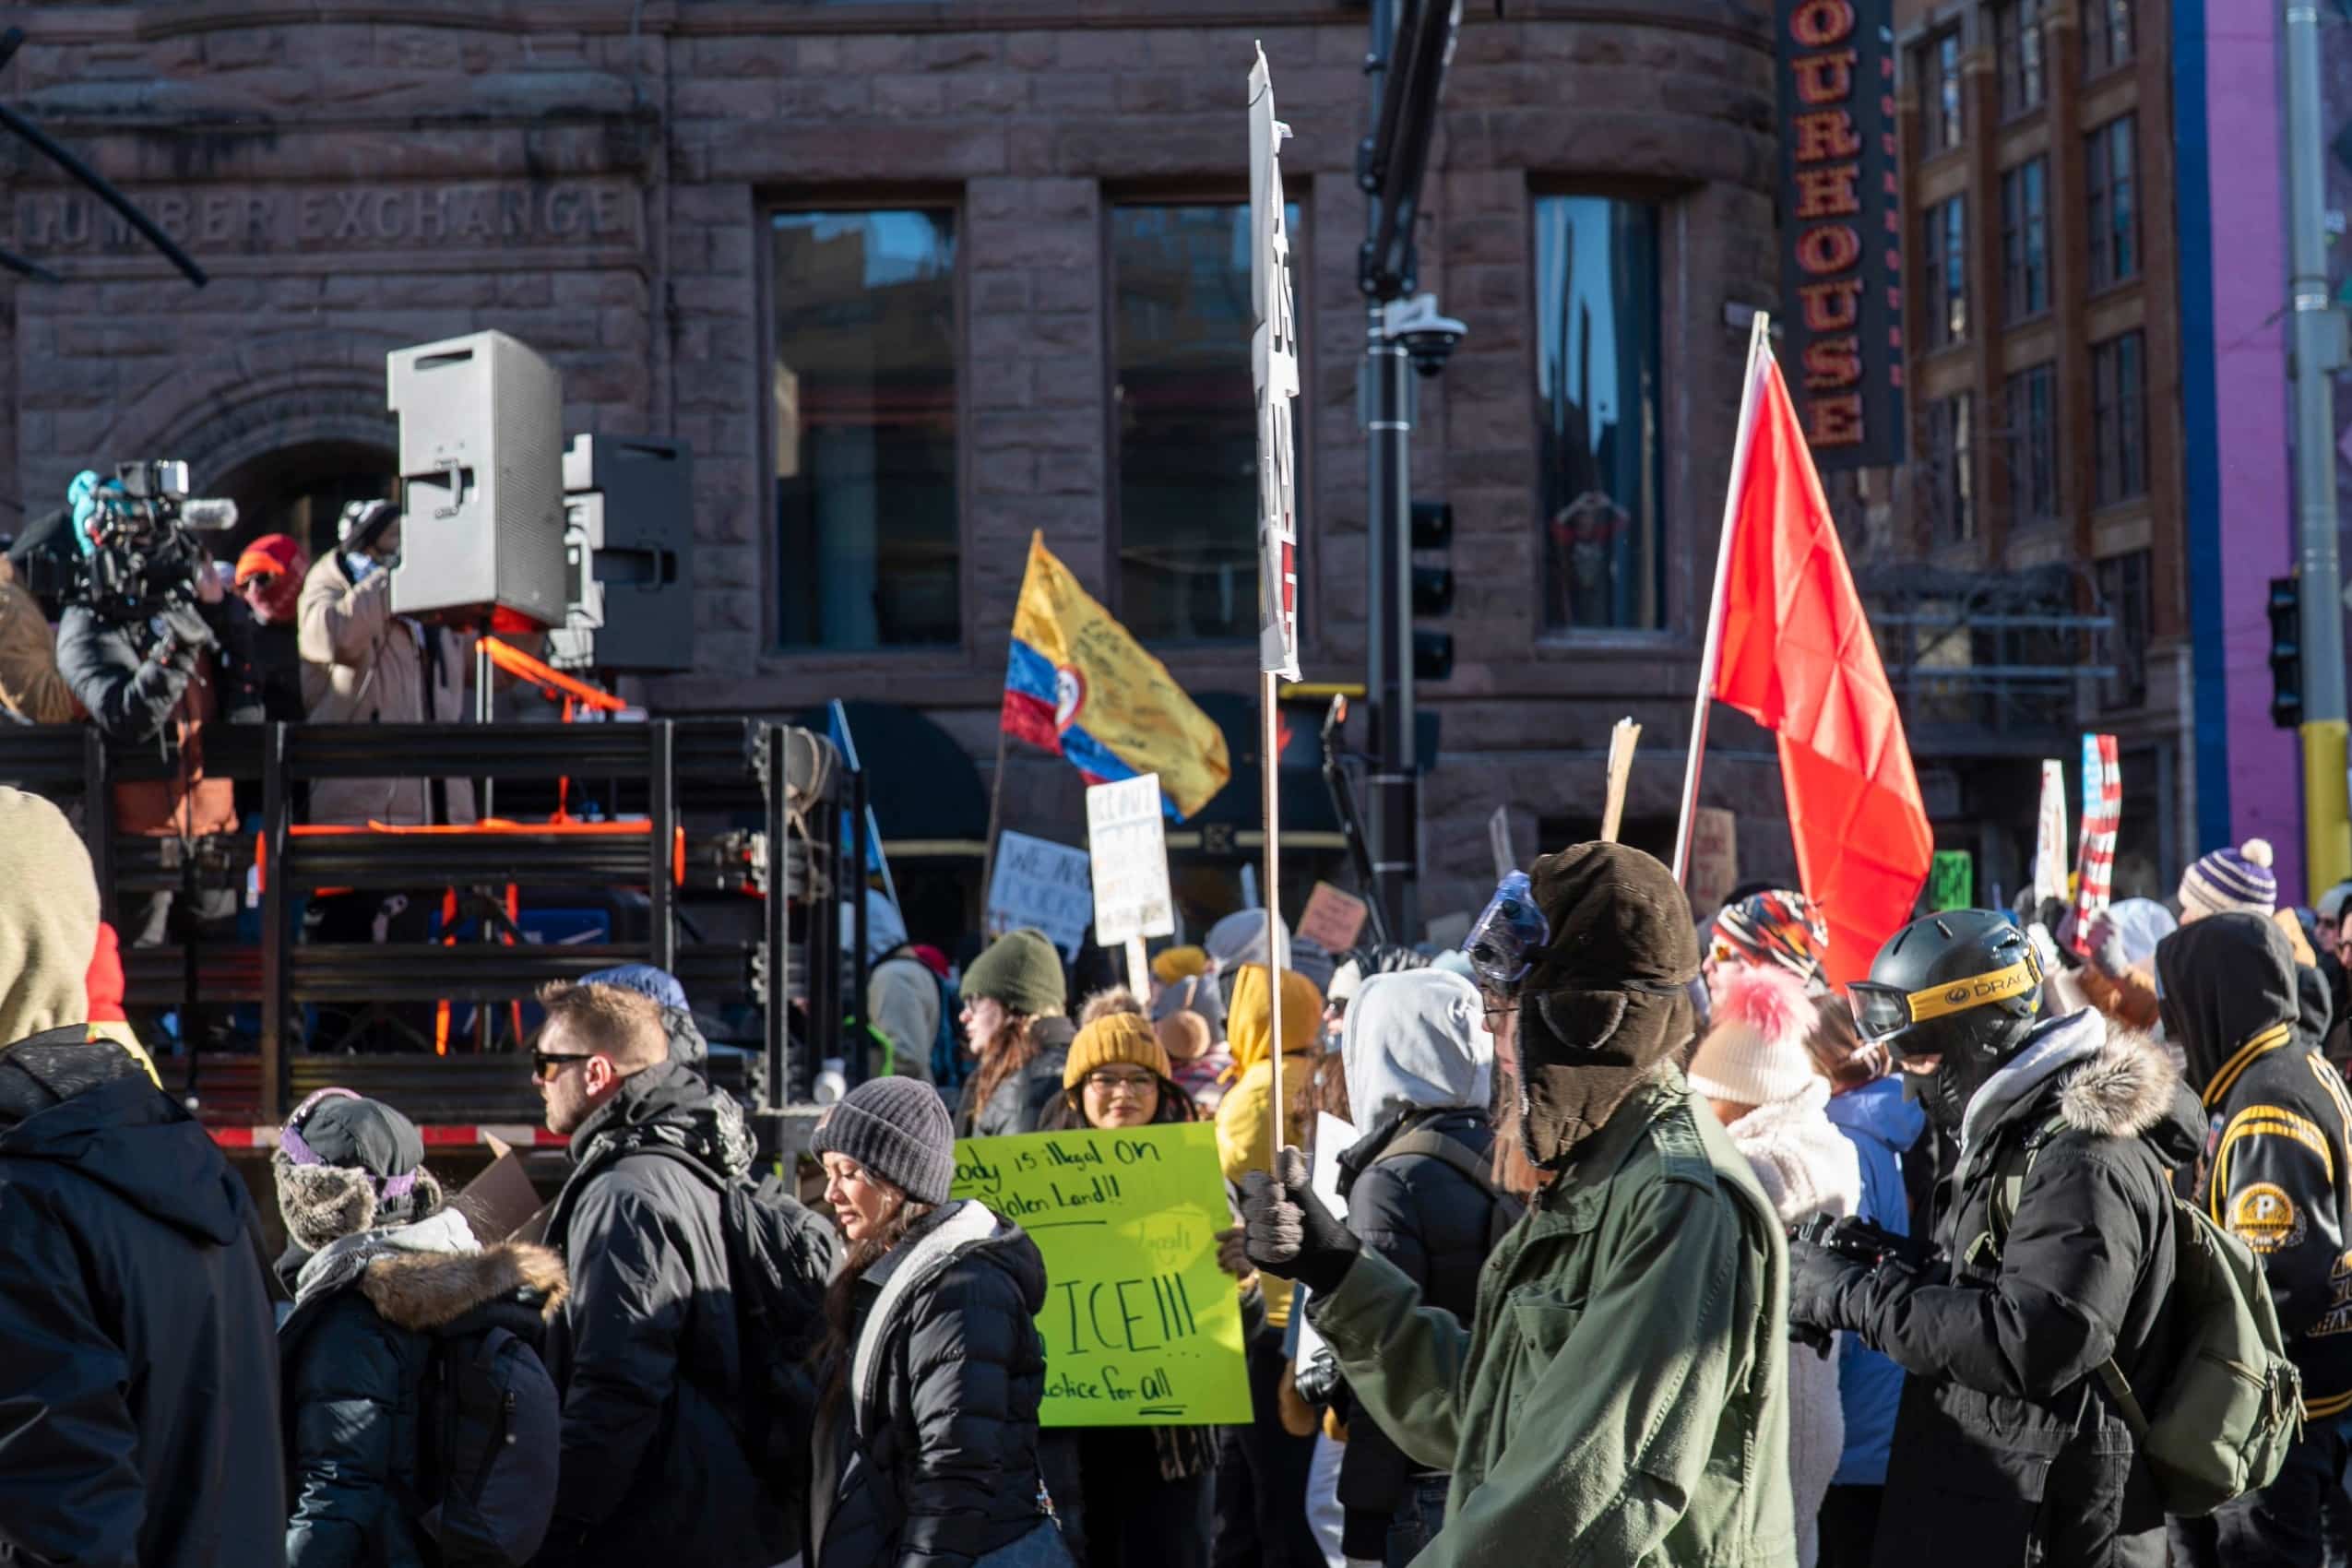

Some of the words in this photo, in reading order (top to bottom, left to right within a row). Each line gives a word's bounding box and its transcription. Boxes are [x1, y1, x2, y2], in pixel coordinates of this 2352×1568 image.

[295, 184, 627, 240] EXCHANGE
[1013, 1151, 1038, 1173] is
[1044, 1139, 1104, 1171] illegal
[2256, 1194, 2276, 1220] P
[1054, 1271, 1201, 1360] ICE!!!
[1100, 1365, 1136, 1401] for
[1140, 1366, 1174, 1401] all
